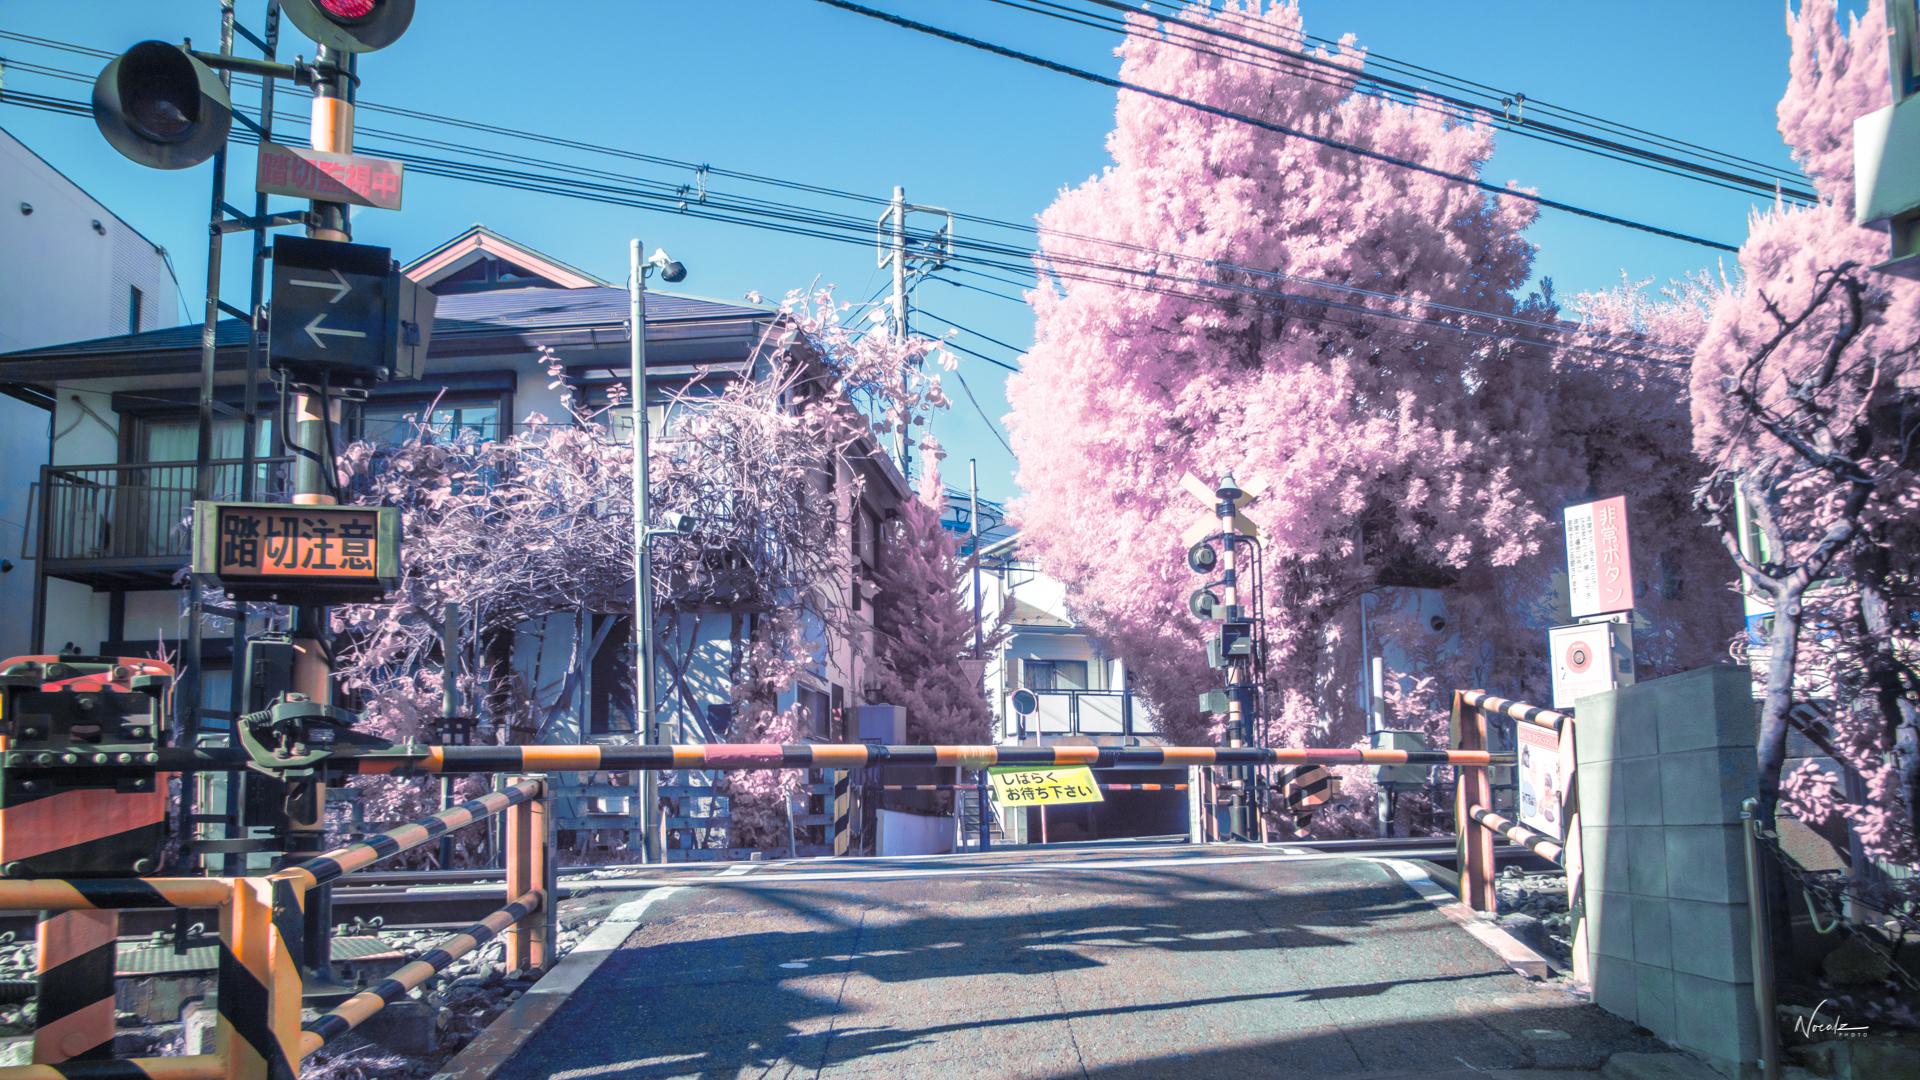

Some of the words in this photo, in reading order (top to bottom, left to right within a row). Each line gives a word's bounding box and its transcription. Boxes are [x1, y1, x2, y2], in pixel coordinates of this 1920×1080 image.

[261, 152, 399, 198] 踏切監視中
[223, 514, 373, 570] 踏切注意
[1599, 505, 1623, 604] 非常ボタン
[1005, 785, 1092, 801] お待ち下さい
